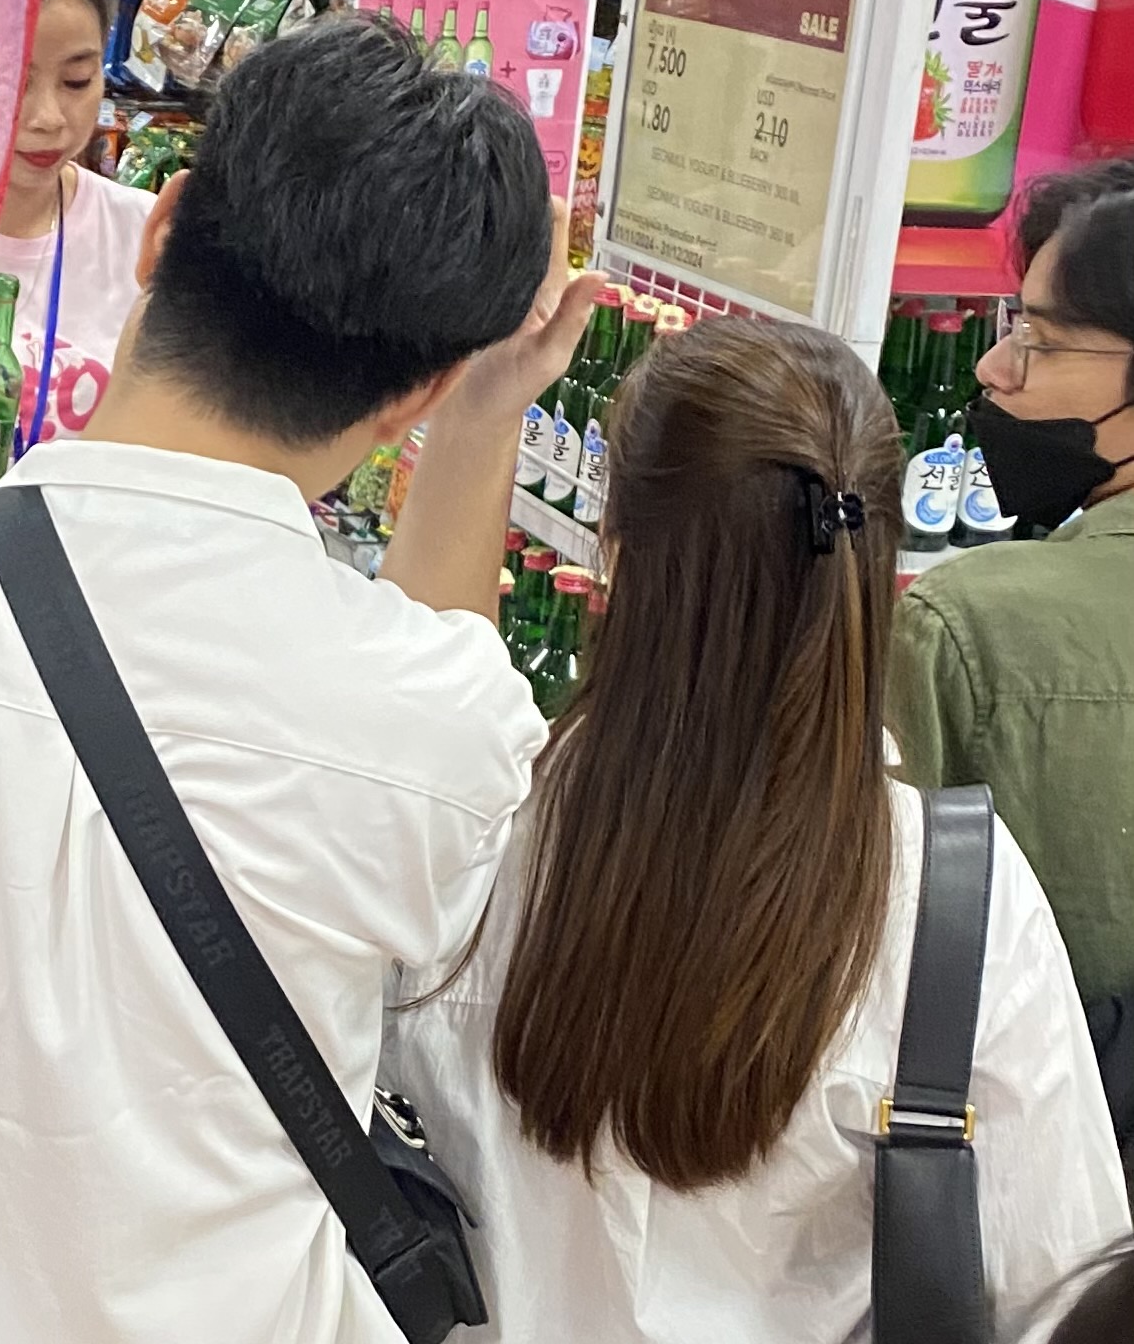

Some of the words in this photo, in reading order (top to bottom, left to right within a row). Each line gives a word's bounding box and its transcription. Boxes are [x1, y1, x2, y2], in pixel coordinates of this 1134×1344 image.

[799, 11, 840, 42] SALE
[646, 42, 686, 78] 7,500
[757, 88, 775, 106] USD
[640, 100, 671, 134] 1.80
[754, 111, 789, 148] 2.10
[259, 1023, 354, 1169] TRAPSTAR
